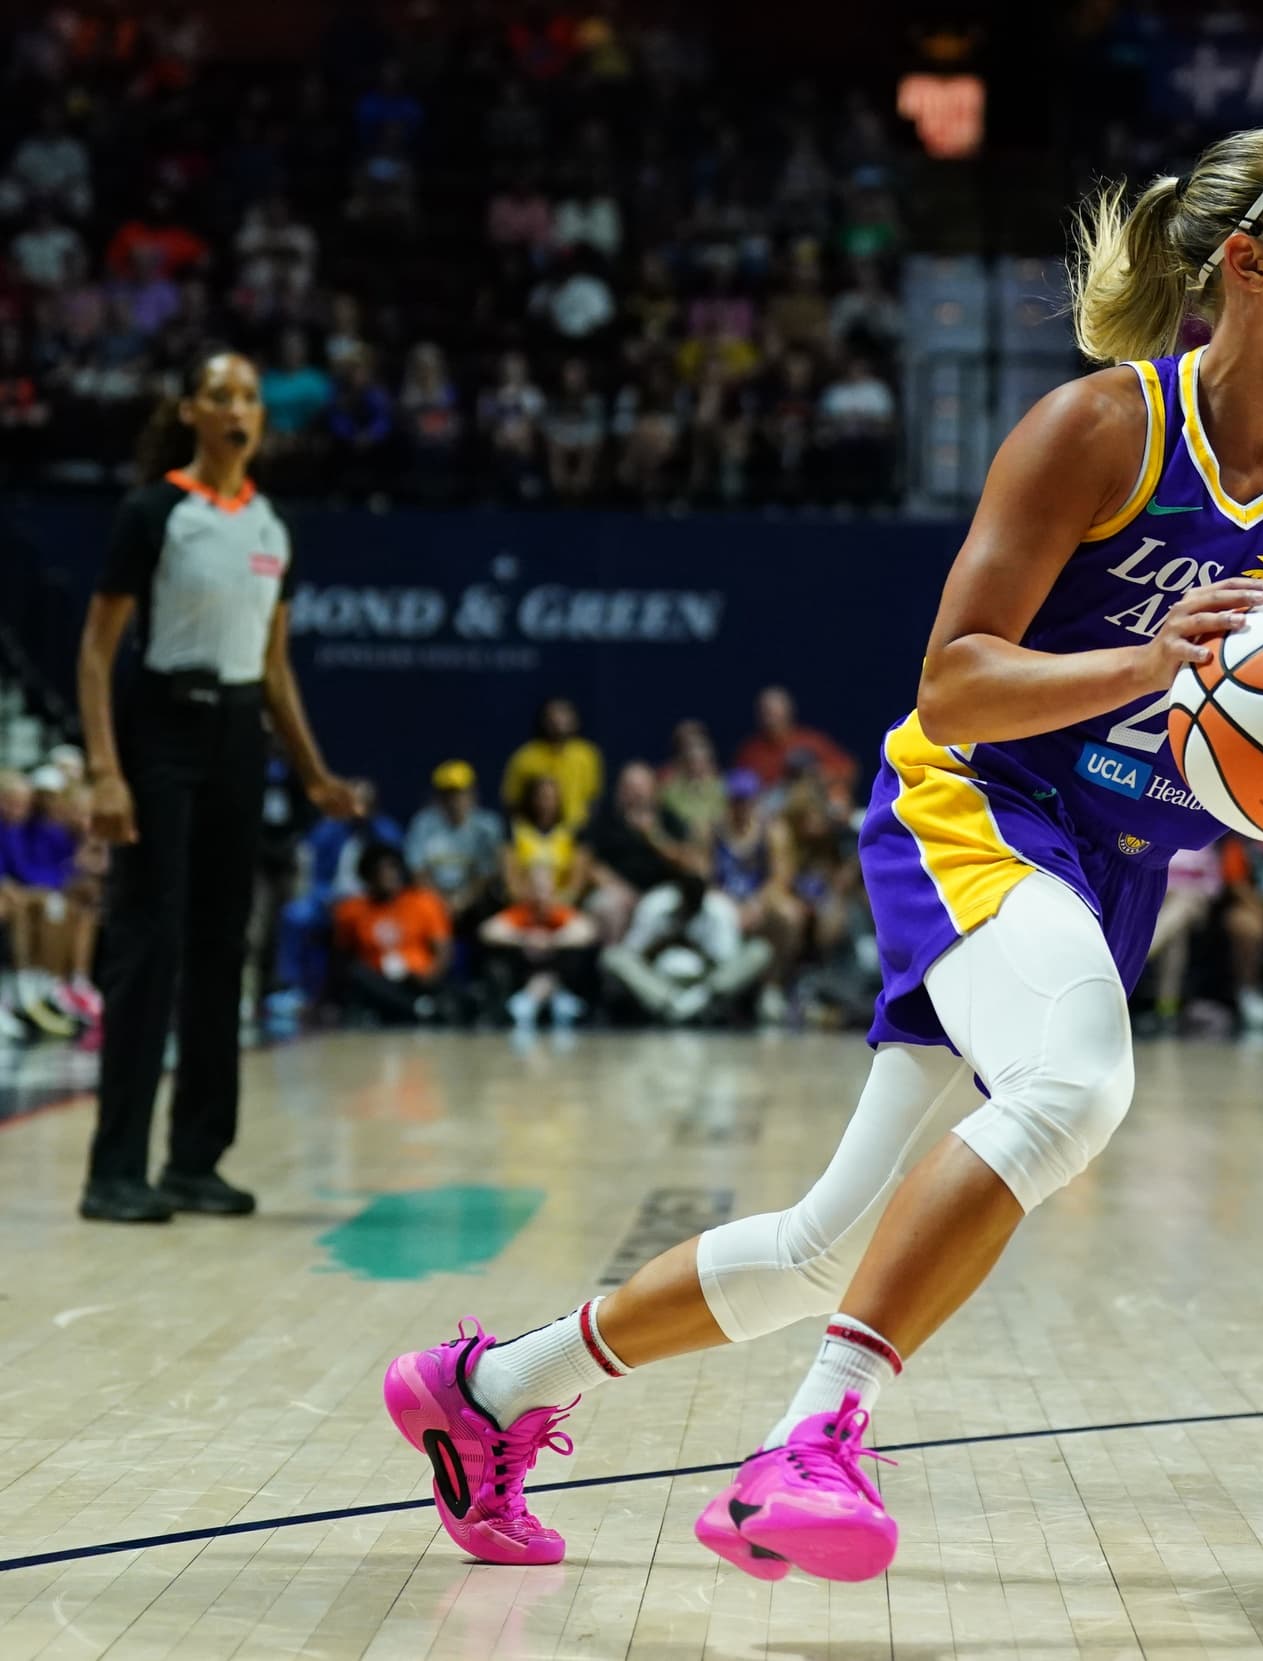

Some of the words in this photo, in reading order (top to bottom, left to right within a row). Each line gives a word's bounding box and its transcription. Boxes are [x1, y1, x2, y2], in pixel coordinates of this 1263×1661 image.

[516, 583, 724, 641] GREEN
[1087, 752, 1137, 789] UCLA
[1145, 774, 1206, 810] Healt
